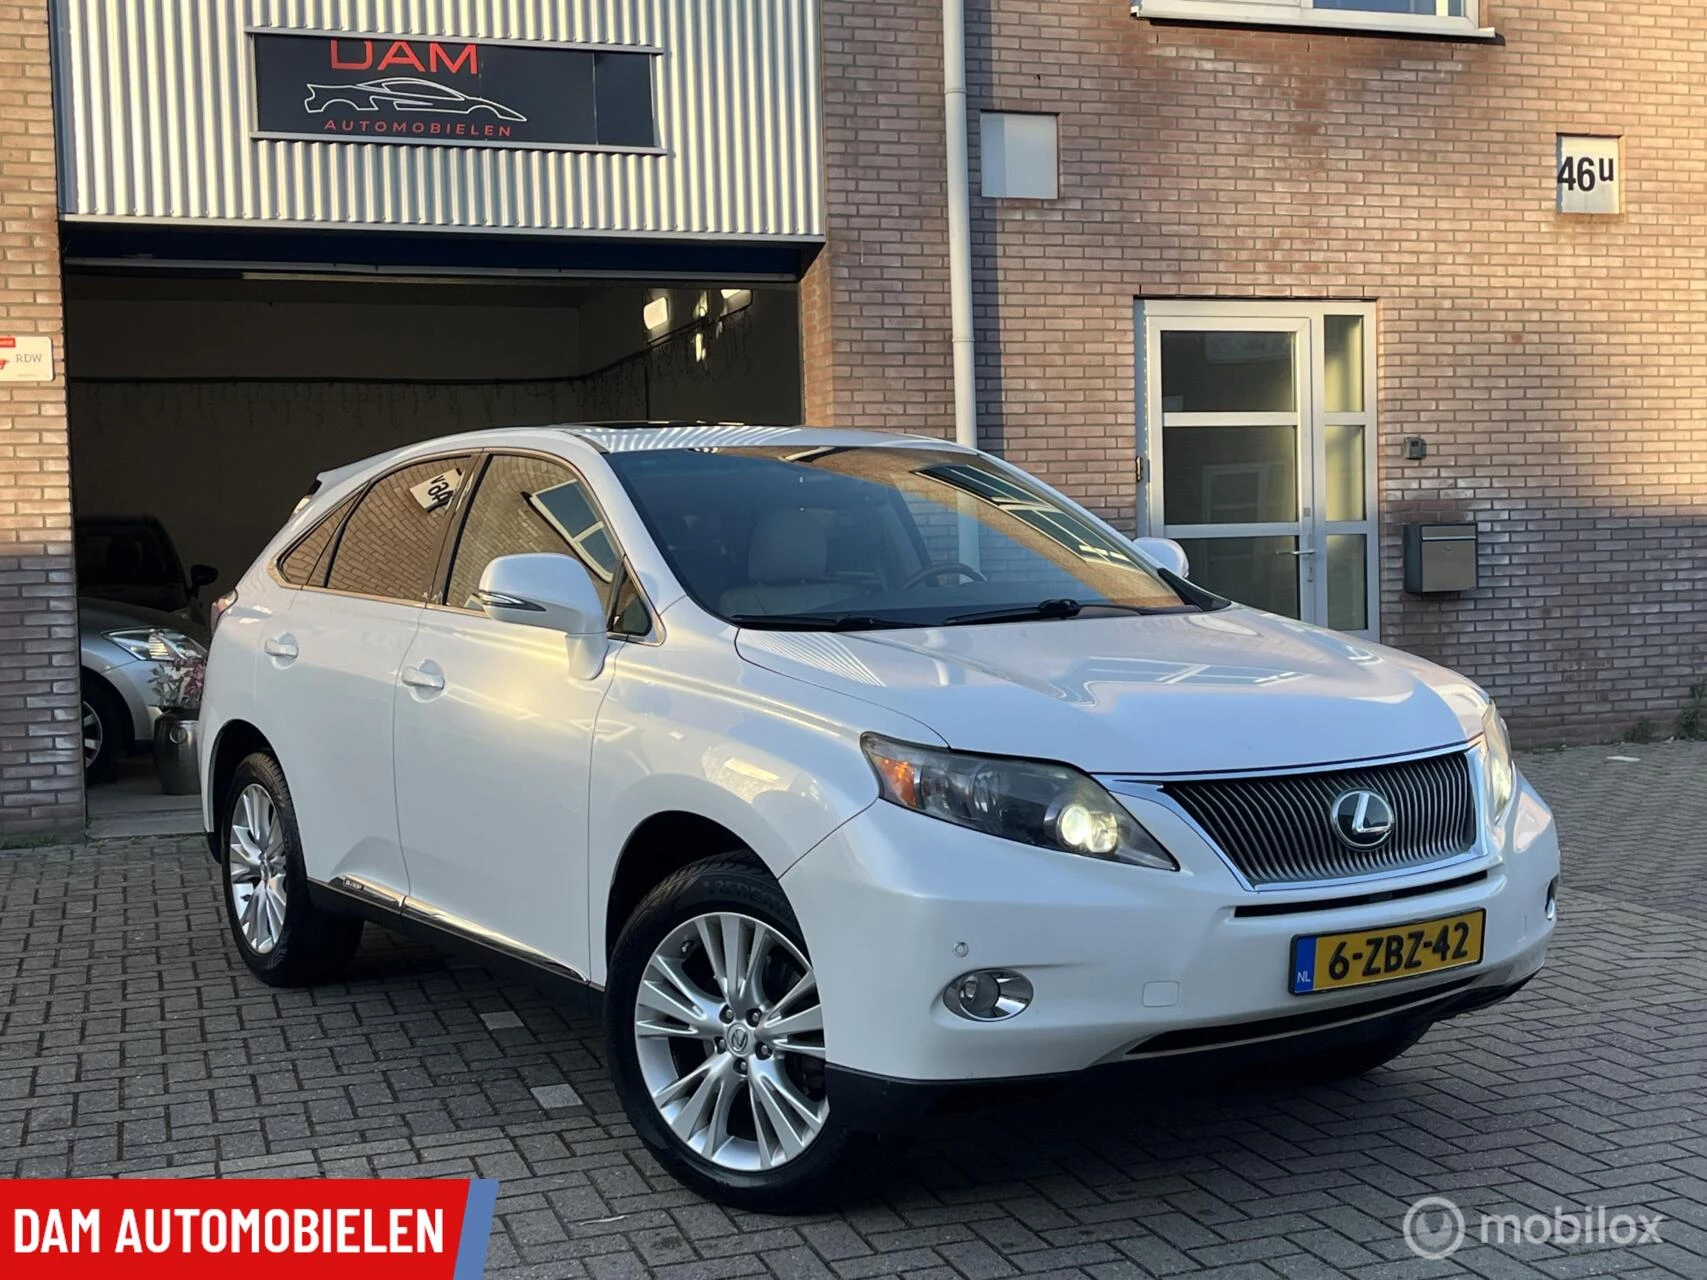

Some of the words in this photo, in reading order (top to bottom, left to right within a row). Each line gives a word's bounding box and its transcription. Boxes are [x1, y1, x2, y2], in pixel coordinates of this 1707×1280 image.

[330, 39, 479, 75] DAM
[324, 119, 513, 137] AUTOMOBIELEN
[1557, 156, 1614, 192] 46u
[16, 353, 42, 364] RDW
[1329, 922, 1470, 981] 6-ZBZ-42
[1296, 971, 1311, 984] NL
